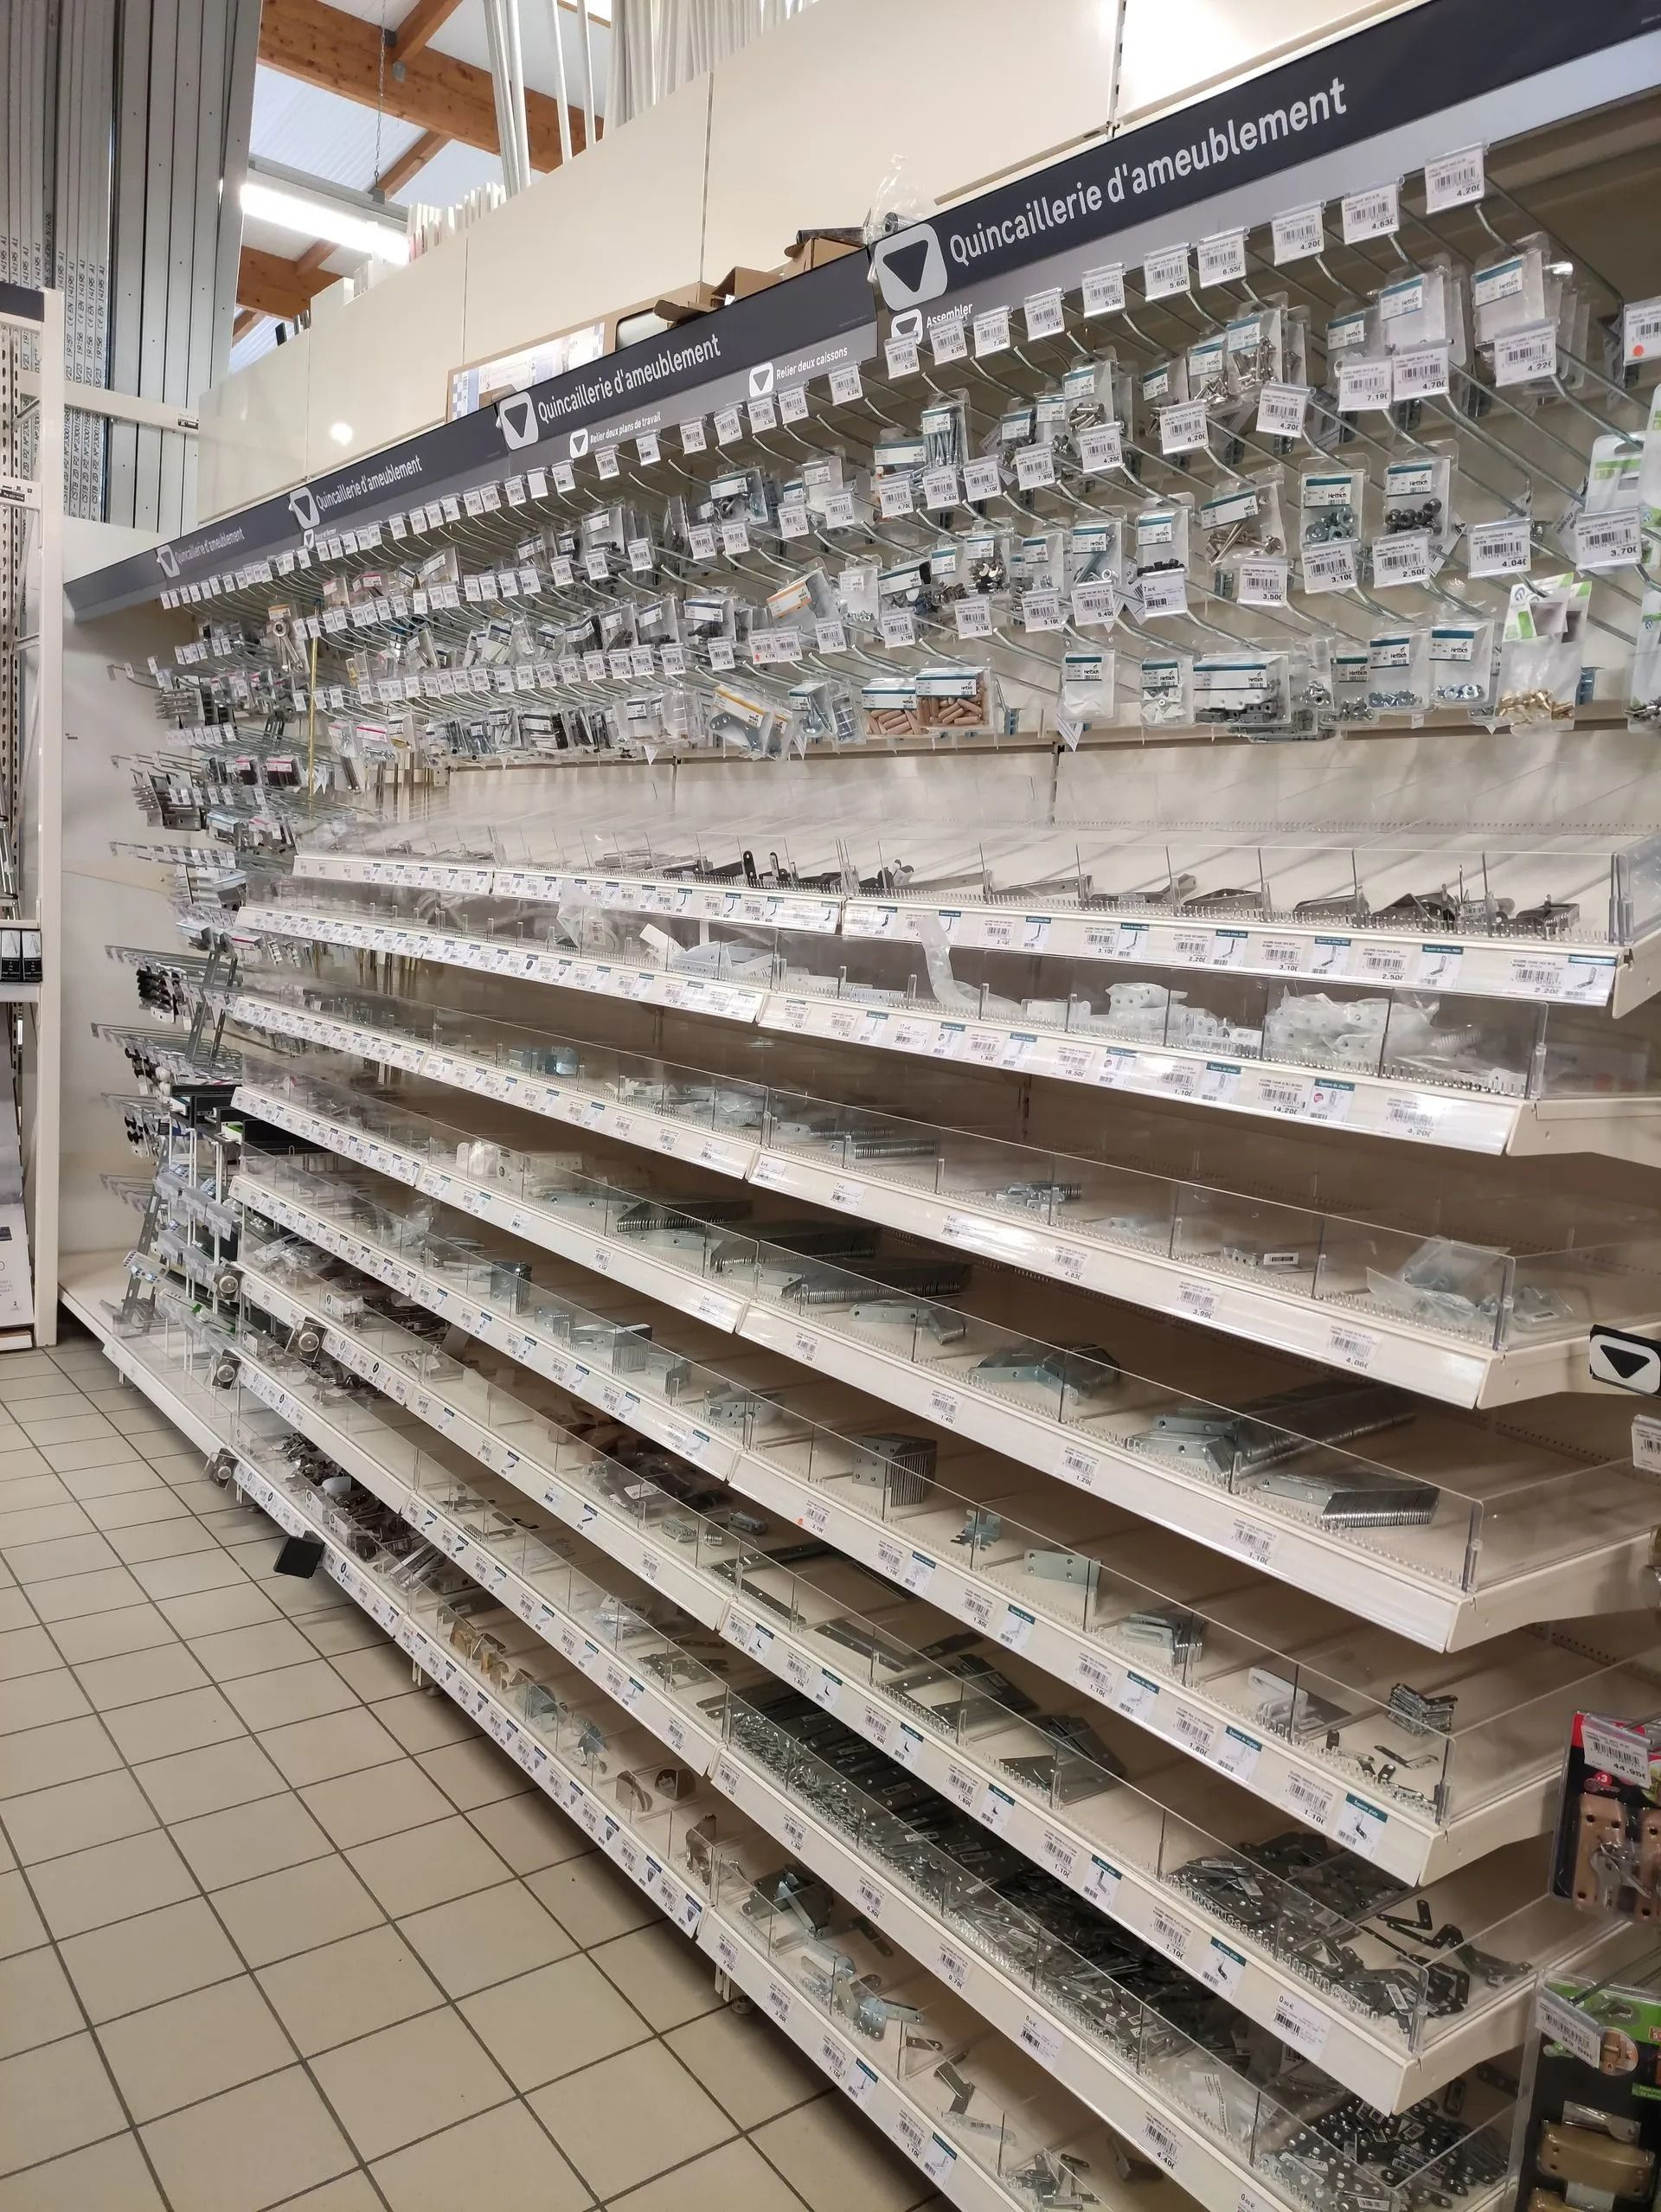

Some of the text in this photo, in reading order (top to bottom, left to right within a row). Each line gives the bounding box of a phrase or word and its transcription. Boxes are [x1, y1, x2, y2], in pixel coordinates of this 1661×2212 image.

[948, 77, 1348, 267] Quincaillerie d'ameublement
[1371, 217, 1395, 230] 4.63€
[88, 305, 94, 316] EN
[98, 306, 104, 317] EN
[927, 304, 973, 329] Assembler
[776, 347, 848, 381] Relier deux caissons
[537, 334, 721, 424] Quincaillerie d'ameublement
[1422, 381, 1446, 389] 4.70€
[590, 411, 661, 445] Relier deux plans de travail
[1188, 433, 1206, 443] 6.20€
[316, 454, 422, 511] Quincaillerie d'ameublement
[1611, 546, 1637, 556] 3.70€
[1502, 559, 1527, 567] 4.04€
[1331, 574, 1352, 583] 3.10€
[1402, 568, 1426, 577] 2.50€
[1305, 1809, 1325, 1825] 1.10€
[1166, 1944, 1184, 1960] 1.10€
